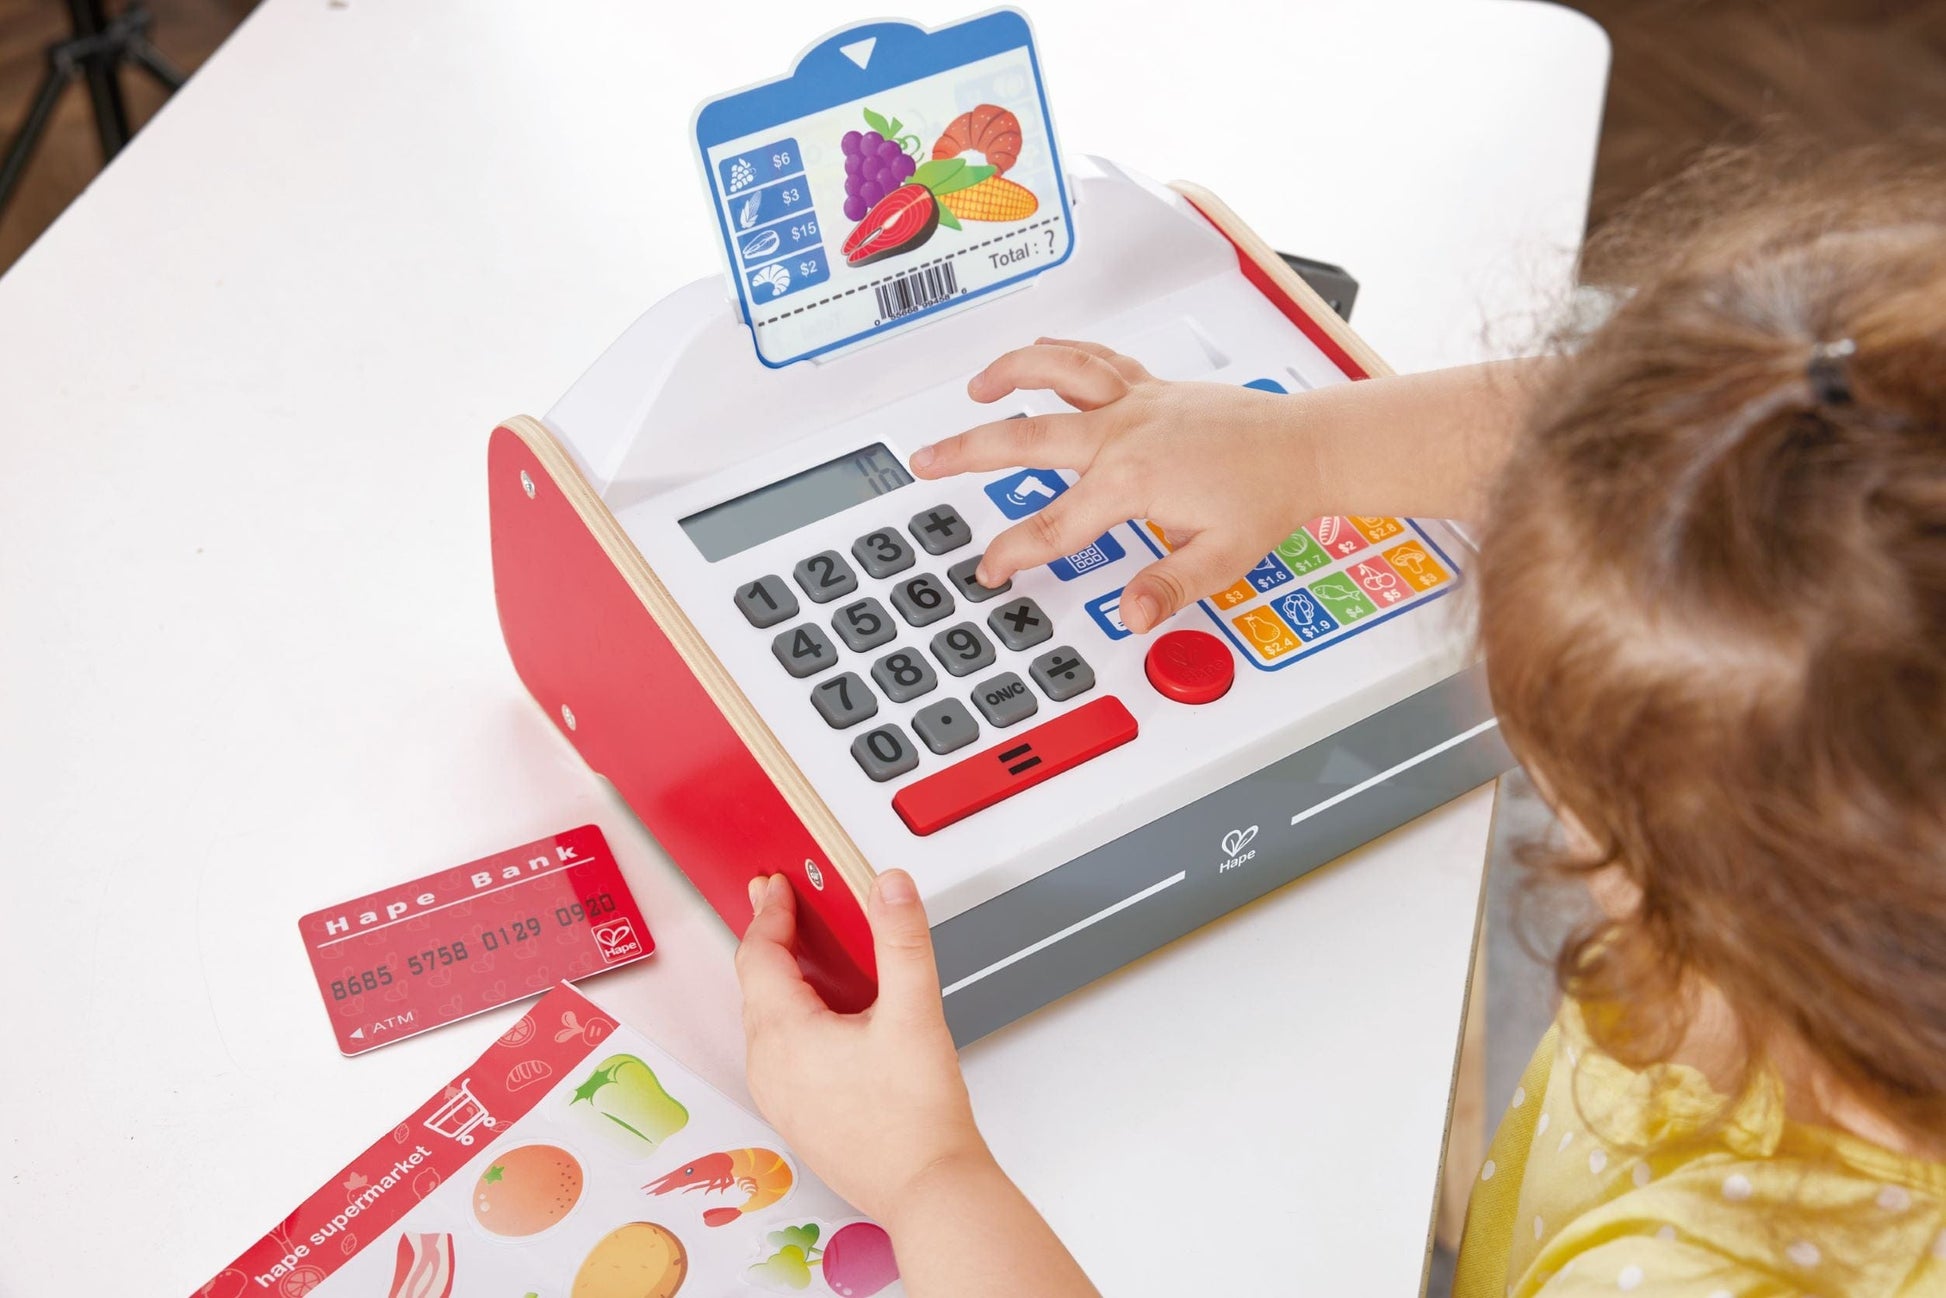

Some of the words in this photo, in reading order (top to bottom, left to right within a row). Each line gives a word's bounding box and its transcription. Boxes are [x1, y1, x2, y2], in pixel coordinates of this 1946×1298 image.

[773, 152, 790, 168] $6
[783, 188, 799, 206] $3
[792, 223, 817, 243] $15
[989, 243, 1030, 269] Total
[801, 261, 817, 278] $2
[1369, 523, 1395, 540] $2.8
[867, 533, 902, 561] 3
[1338, 540, 1358, 555] $2
[808, 556, 847, 588] 2
[1295, 555, 1323, 572] $1.7
[1257, 571, 1287, 590] $1.6
[1419, 573, 1438, 587] $3
[748, 582, 779, 610] 1
[908, 578, 941, 609] 6
[1226, 591, 1244, 604] $3
[1383, 588, 1402, 602] $5
[846, 597, 882, 636] 5
[1345, 605, 1364, 619] $4
[1302, 619, 1331, 638] $1.9
[792, 629, 822, 659] 4
[946, 630, 981, 660] 9
[1264, 638, 1294, 656] $2.4
[886, 655, 922, 685] 8
[821, 678, 852, 711] 7
[986, 682, 1025, 707] ON/C
[868, 730, 902, 763] 0
[1218, 848, 1257, 874] Hape
[325, 890, 436, 936] Hape
[470, 845, 579, 889] Bank
[331, 966, 394, 1001] 8685
[408, 941, 468, 977] 5758
[482, 917, 542, 951] 0129
[555, 893, 616, 928] 0920
[604, 940, 638, 958] Hape
[372, 1011, 414, 1035] ATM
[254, 1244, 310, 1289] hape
[309, 1144, 433, 1247] supermarket
